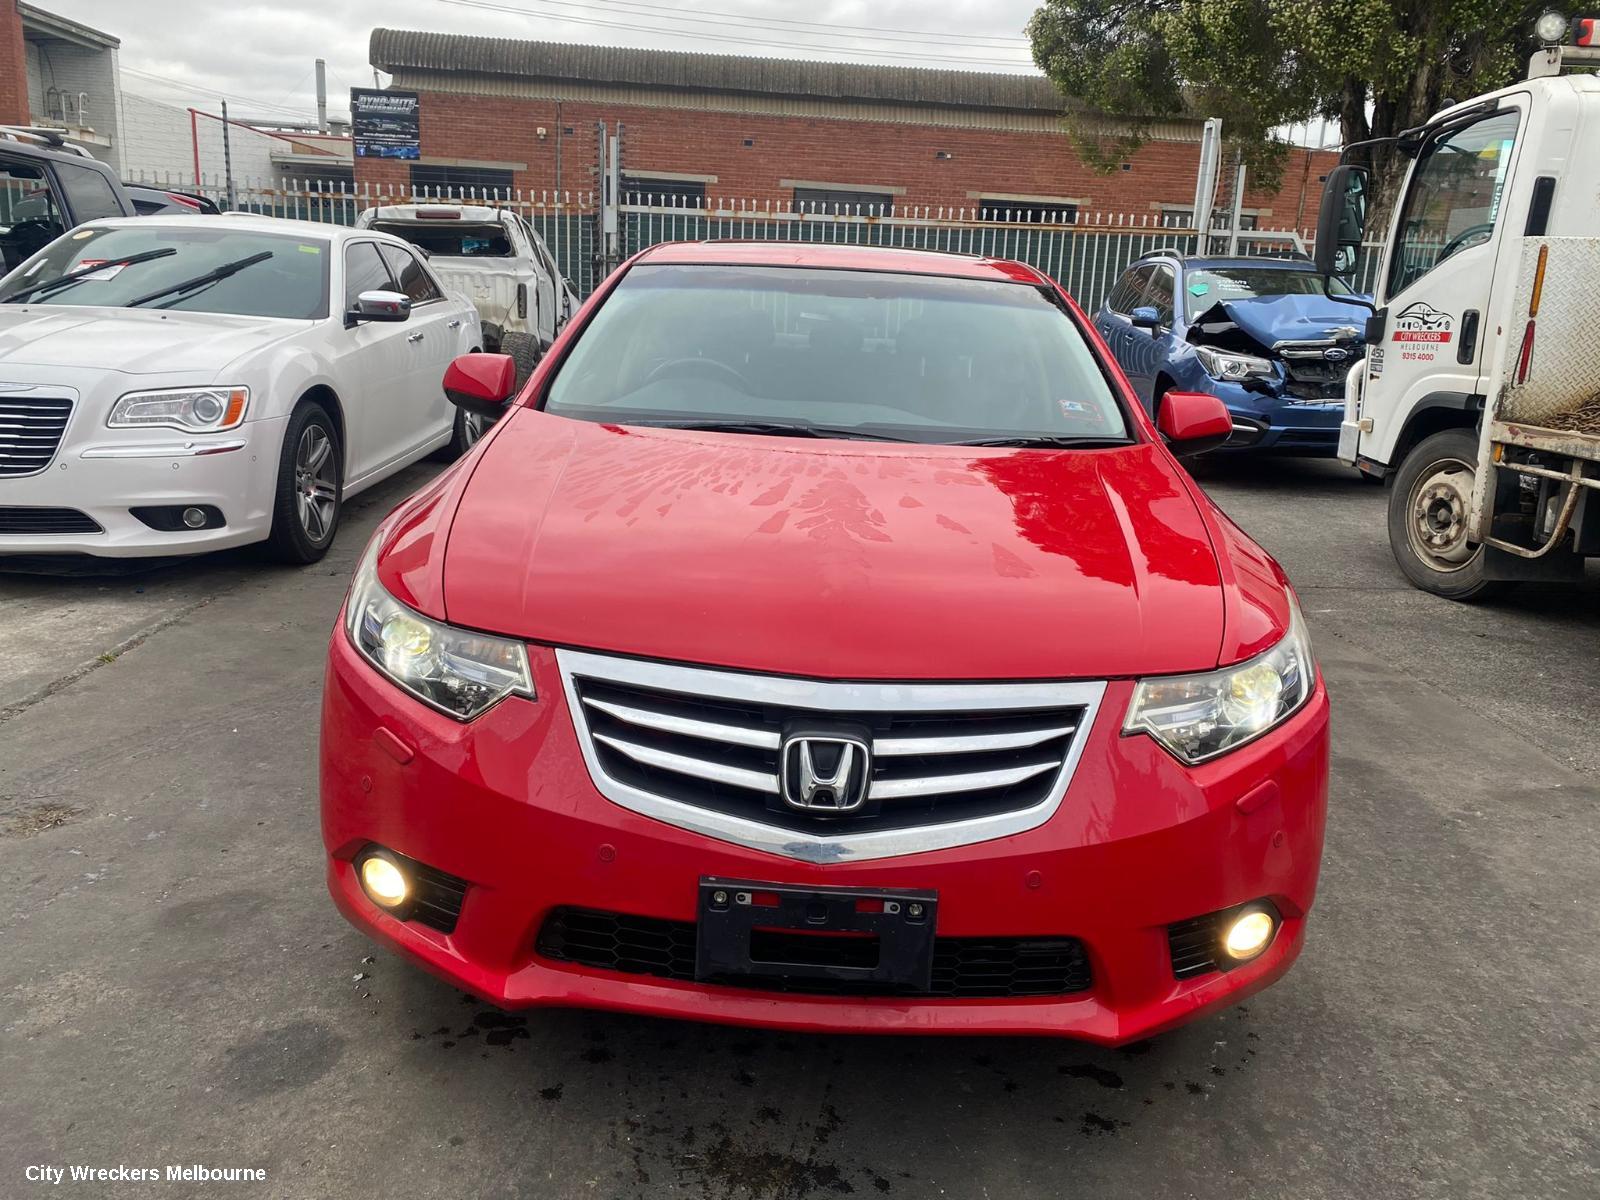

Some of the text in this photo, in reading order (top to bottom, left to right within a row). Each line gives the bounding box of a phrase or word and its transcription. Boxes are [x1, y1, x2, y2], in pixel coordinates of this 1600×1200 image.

[358, 96, 416, 109] DYNO-MITE
[1401, 332, 1441, 341] CITY WRECKERS
[1401, 343, 1439, 352] MELBOURNE
[1371, 348, 1385, 358] 450
[1402, 352, 1434, 361] 9315 4000
